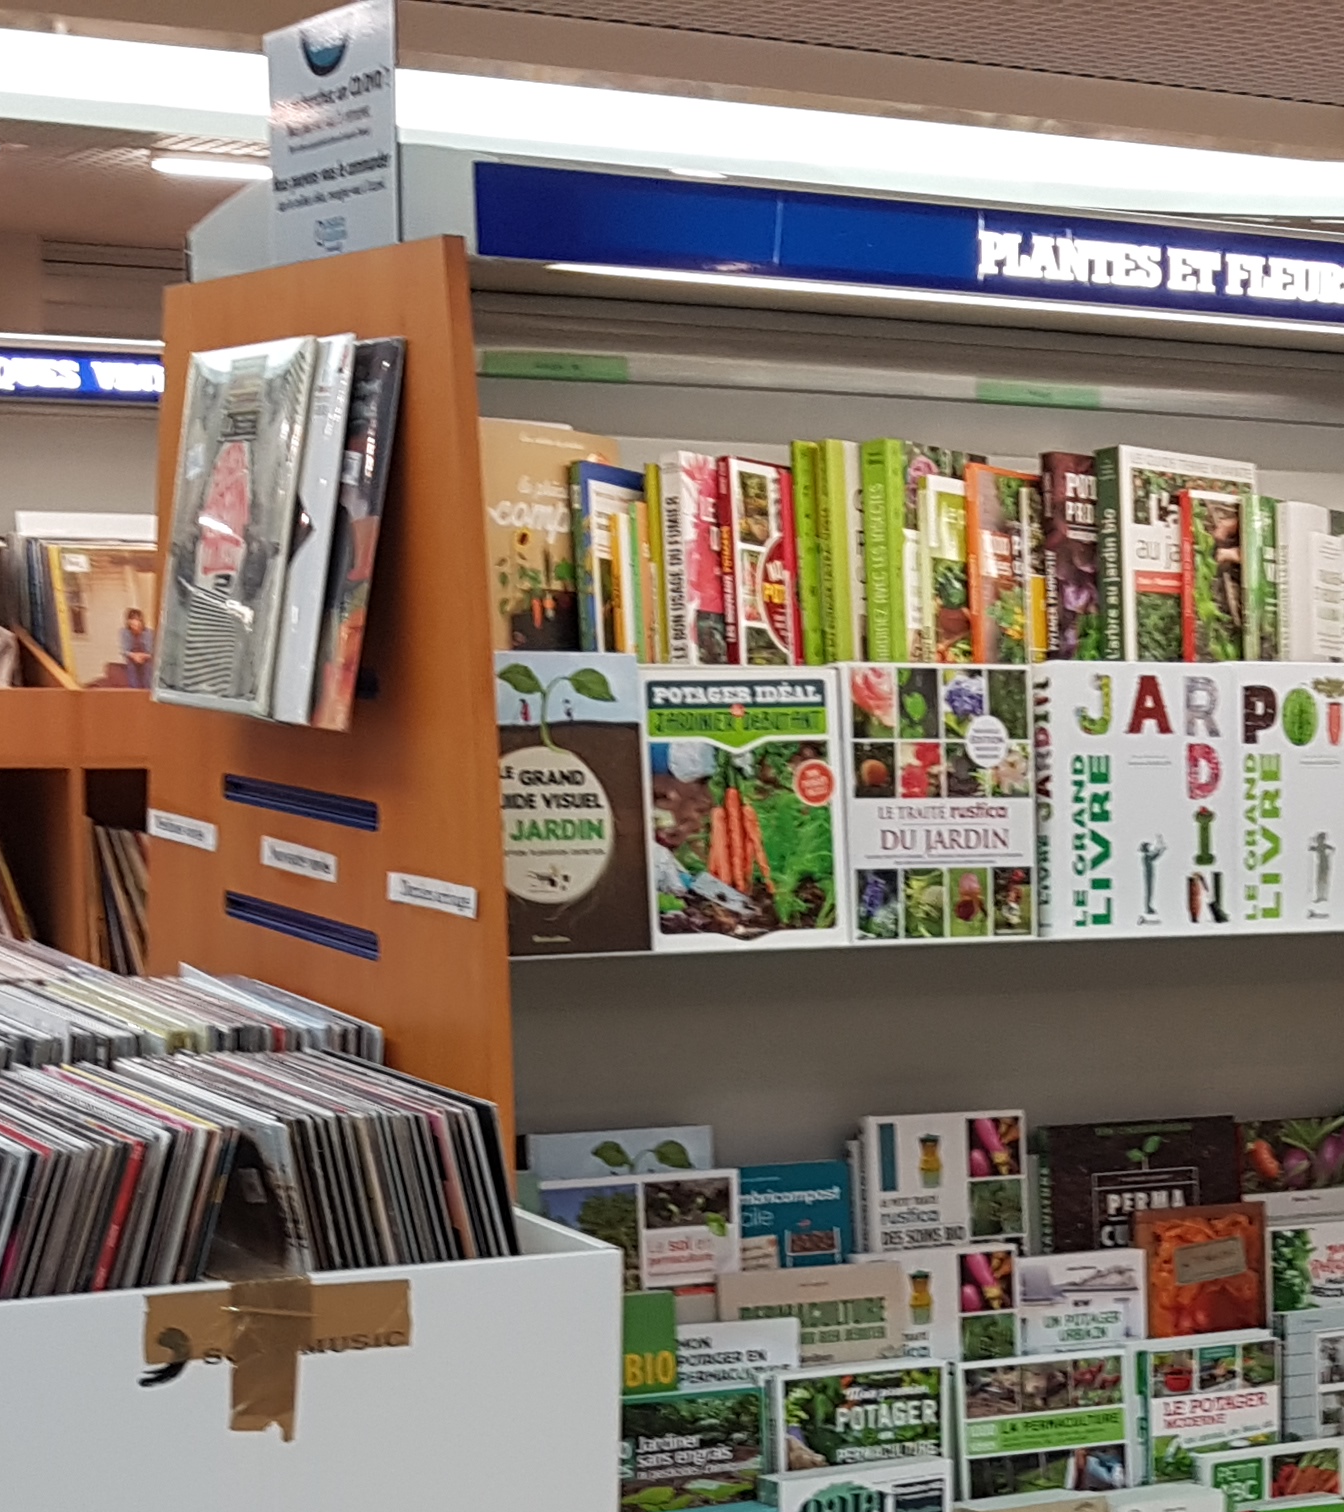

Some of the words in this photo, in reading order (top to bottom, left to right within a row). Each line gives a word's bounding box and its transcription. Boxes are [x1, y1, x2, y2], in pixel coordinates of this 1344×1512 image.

[978, 226, 1163, 288] PLANTES
[1166, 247, 1223, 294] ET
[1102, 507, 1117, 532] bio
[1102, 535, 1122, 582] jardin
[651, 685, 754, 706] POTAGER
[755, 681, 823, 705] IDÉAL
[518, 769, 586, 787] GRAND
[540, 793, 605, 811] VISUEL
[877, 806, 894, 820] LE
[509, 817, 605, 843] JARDIN
[880, 829, 918, 851] DU
[923, 828, 1010, 853] JARDIN
[1087, 754, 1112, 926] LIVRE
[1259, 753, 1283, 919] LIVRE
[623, 1351, 677, 1389] BIO
[1189, 1391, 1268, 1415] POTAGER
[835, 1399, 939, 1433] POTAGER
[1022, 1411, 1120, 1432] PERMACULTURE
[637, 1434, 703, 1455] Jardiner
